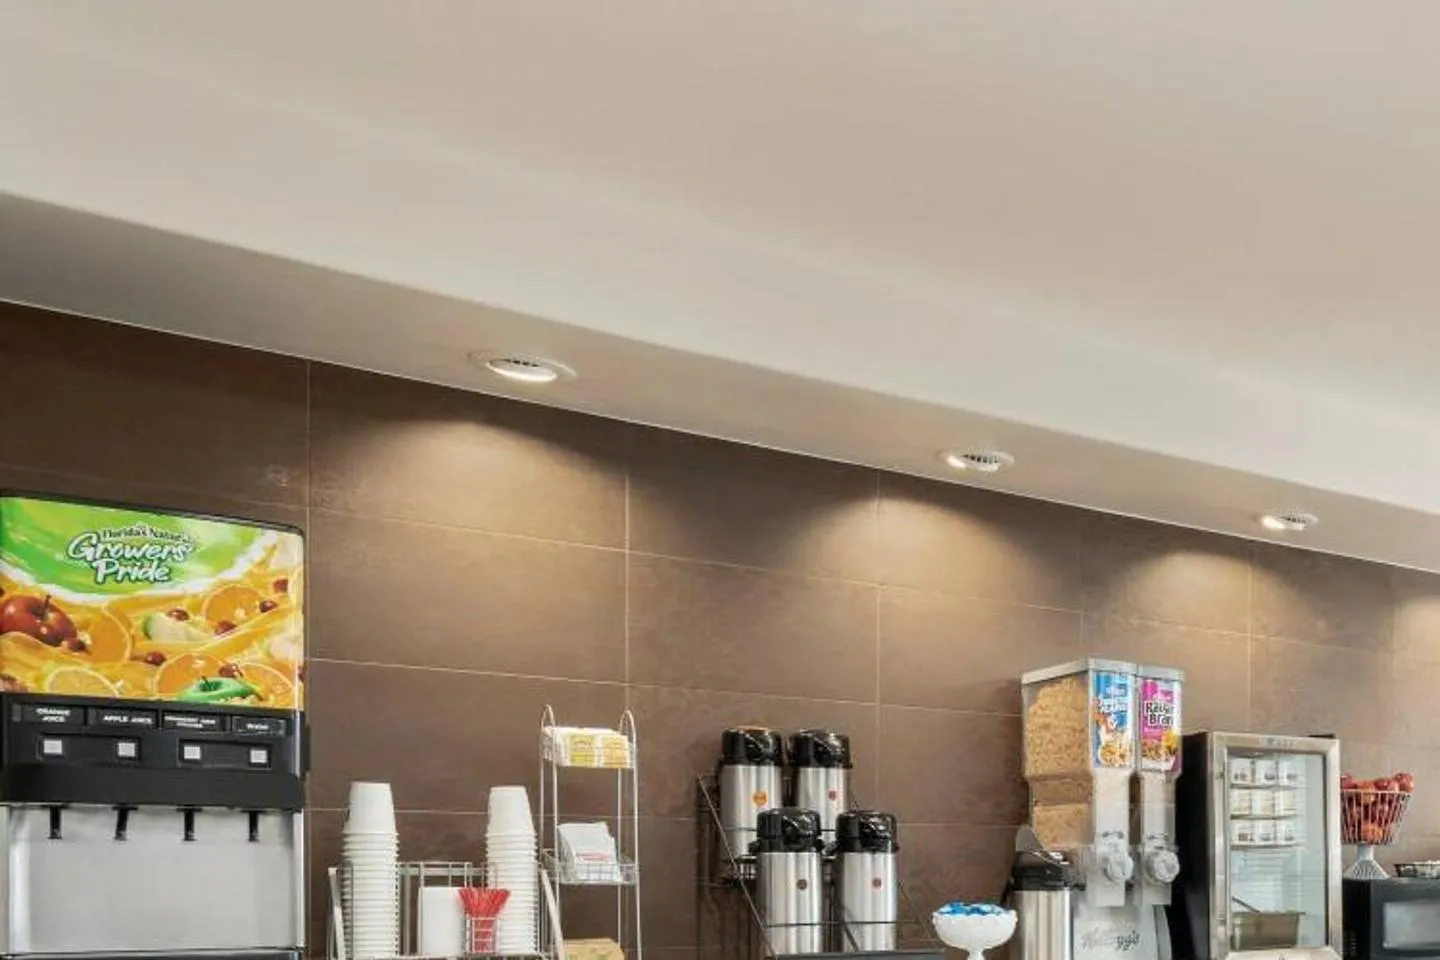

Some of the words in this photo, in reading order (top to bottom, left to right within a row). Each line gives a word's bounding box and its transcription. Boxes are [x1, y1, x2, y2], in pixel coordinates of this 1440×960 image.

[92, 558, 171, 584] Pride
[1145, 701, 1176, 714] Rais
[103, 715, 129, 723] APPLE
[1081, 926, 1140, 951] Kgg's
